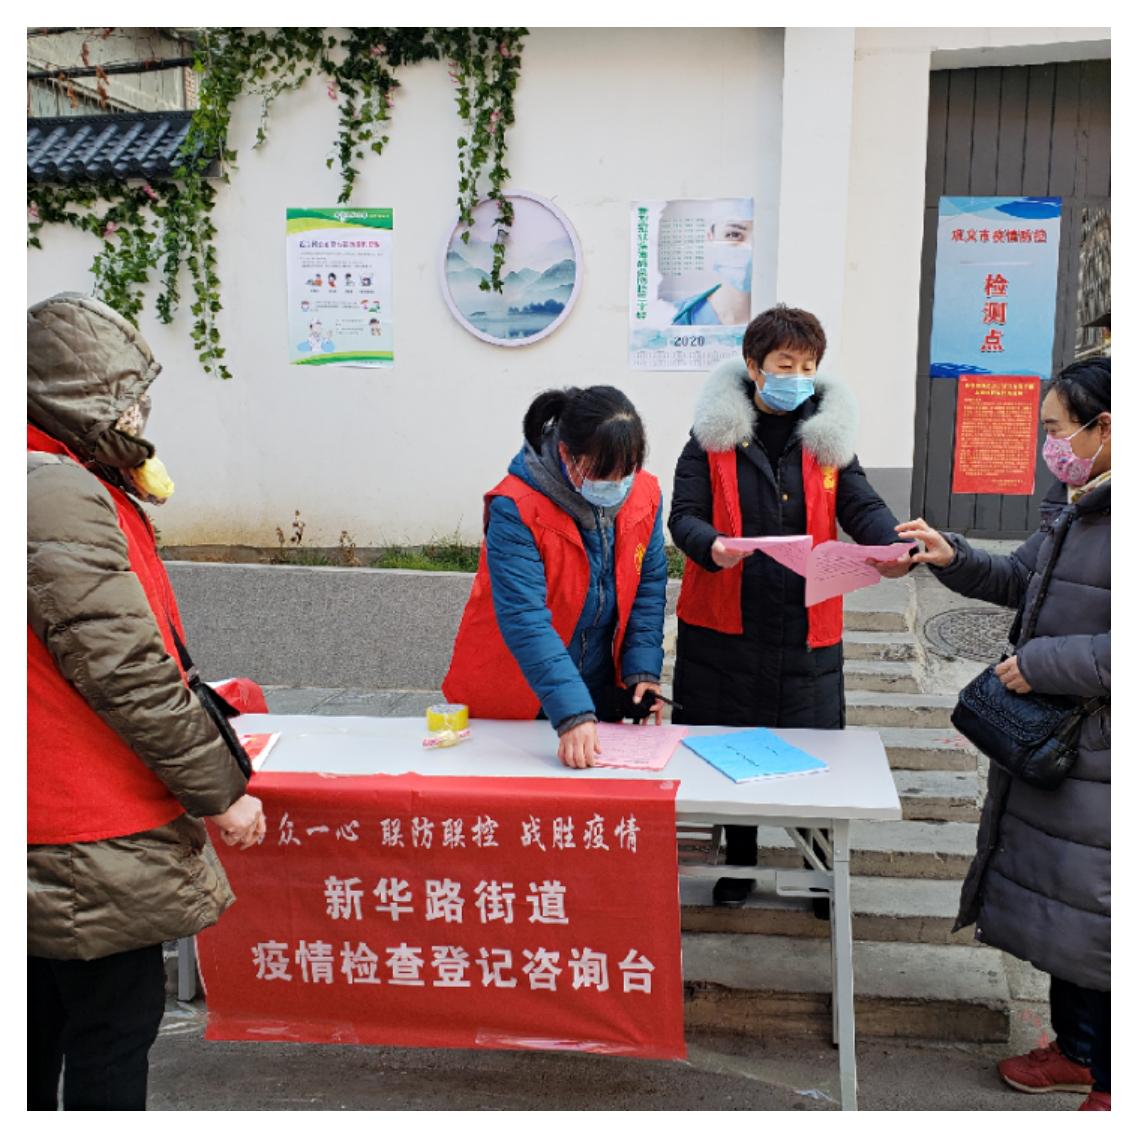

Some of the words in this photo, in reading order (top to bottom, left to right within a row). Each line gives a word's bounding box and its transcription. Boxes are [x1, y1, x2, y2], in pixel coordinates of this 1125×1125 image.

[981, 273, 1009, 352] 检测点
[673, 335, 705, 347] 2020
[256, 812, 361, 848] 众一心
[380, 815, 500, 850] 联防联控
[520, 812, 642, 853] 战胜疫情
[323, 876, 569, 925] 新华路街道
[252, 939, 656, 995] 疫情检查登记咨询台
